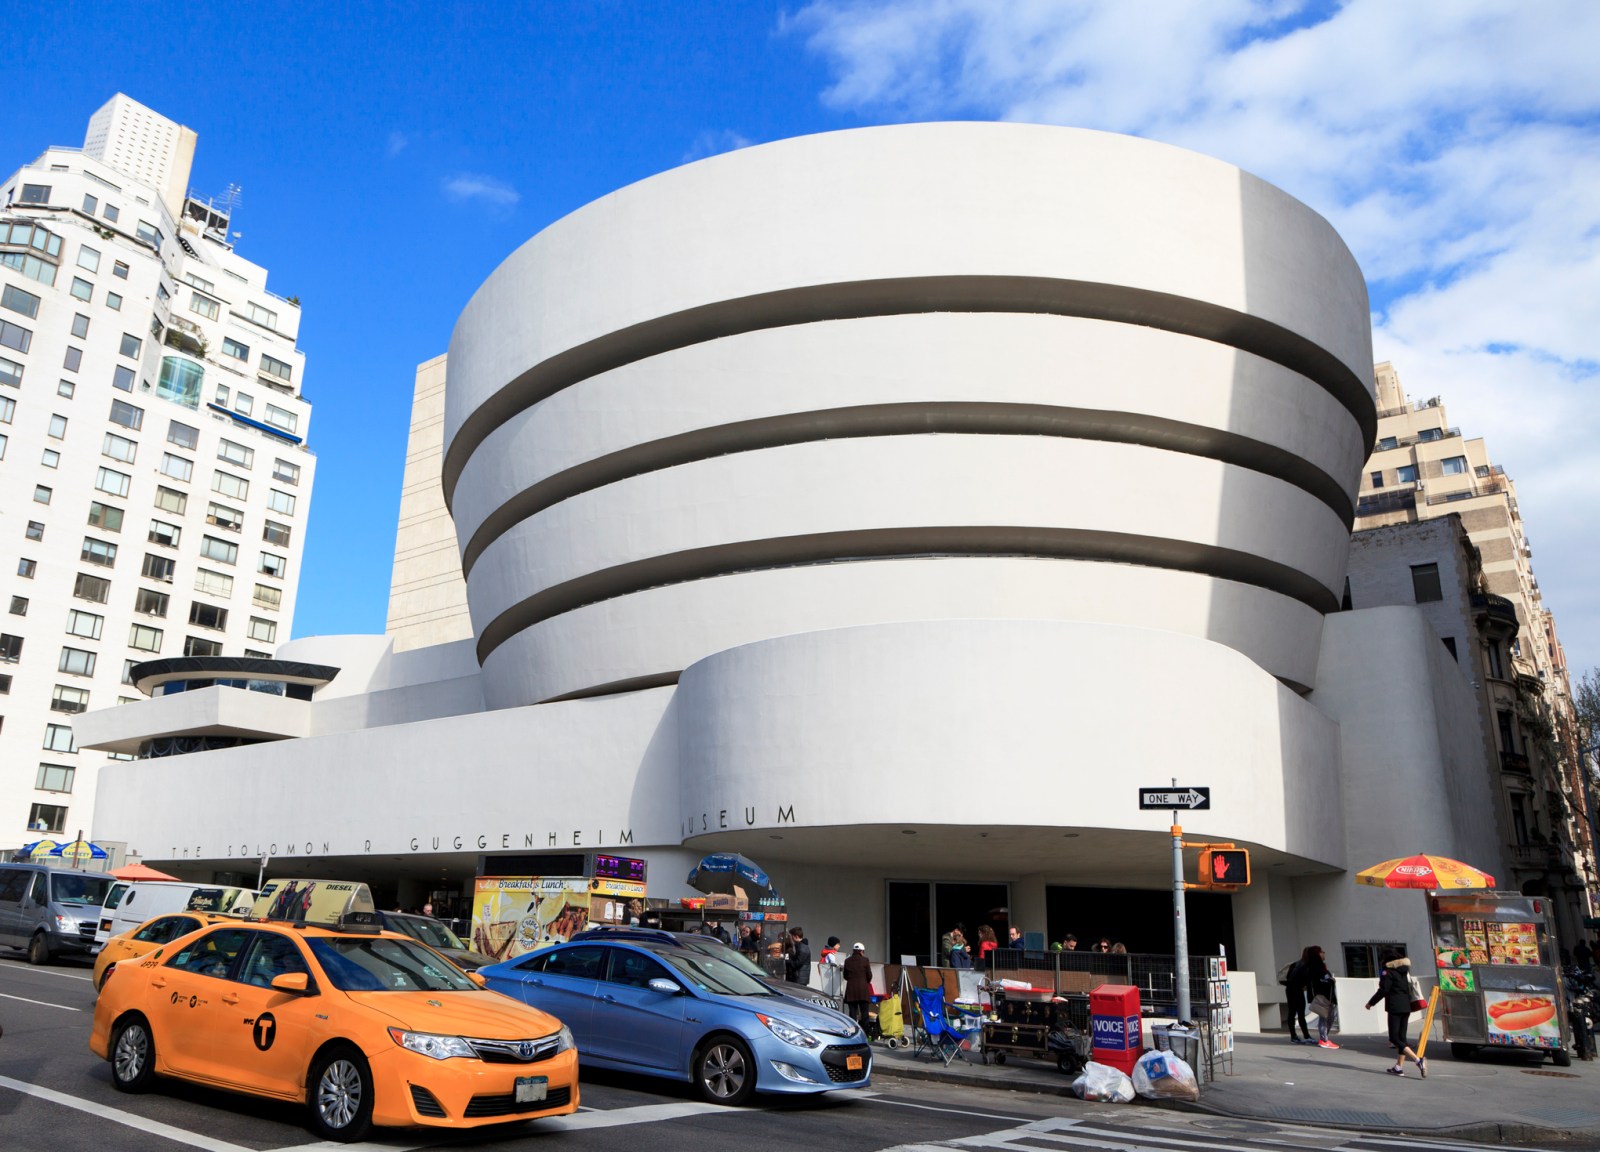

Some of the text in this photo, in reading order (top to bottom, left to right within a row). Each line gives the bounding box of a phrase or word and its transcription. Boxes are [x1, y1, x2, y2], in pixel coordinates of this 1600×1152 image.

[1149, 794, 1198, 804] ONE WAY
[172, 846, 201, 858] THE
[228, 841, 330, 857] SOLOMON
[364, 840, 371, 852] R
[410, 830, 634, 851] GUGGENHEIM
[498, 878, 533, 890] Breakfast
[542, 878, 564, 890] Lunch
[1096, 1020, 1124, 1034] VOICE
